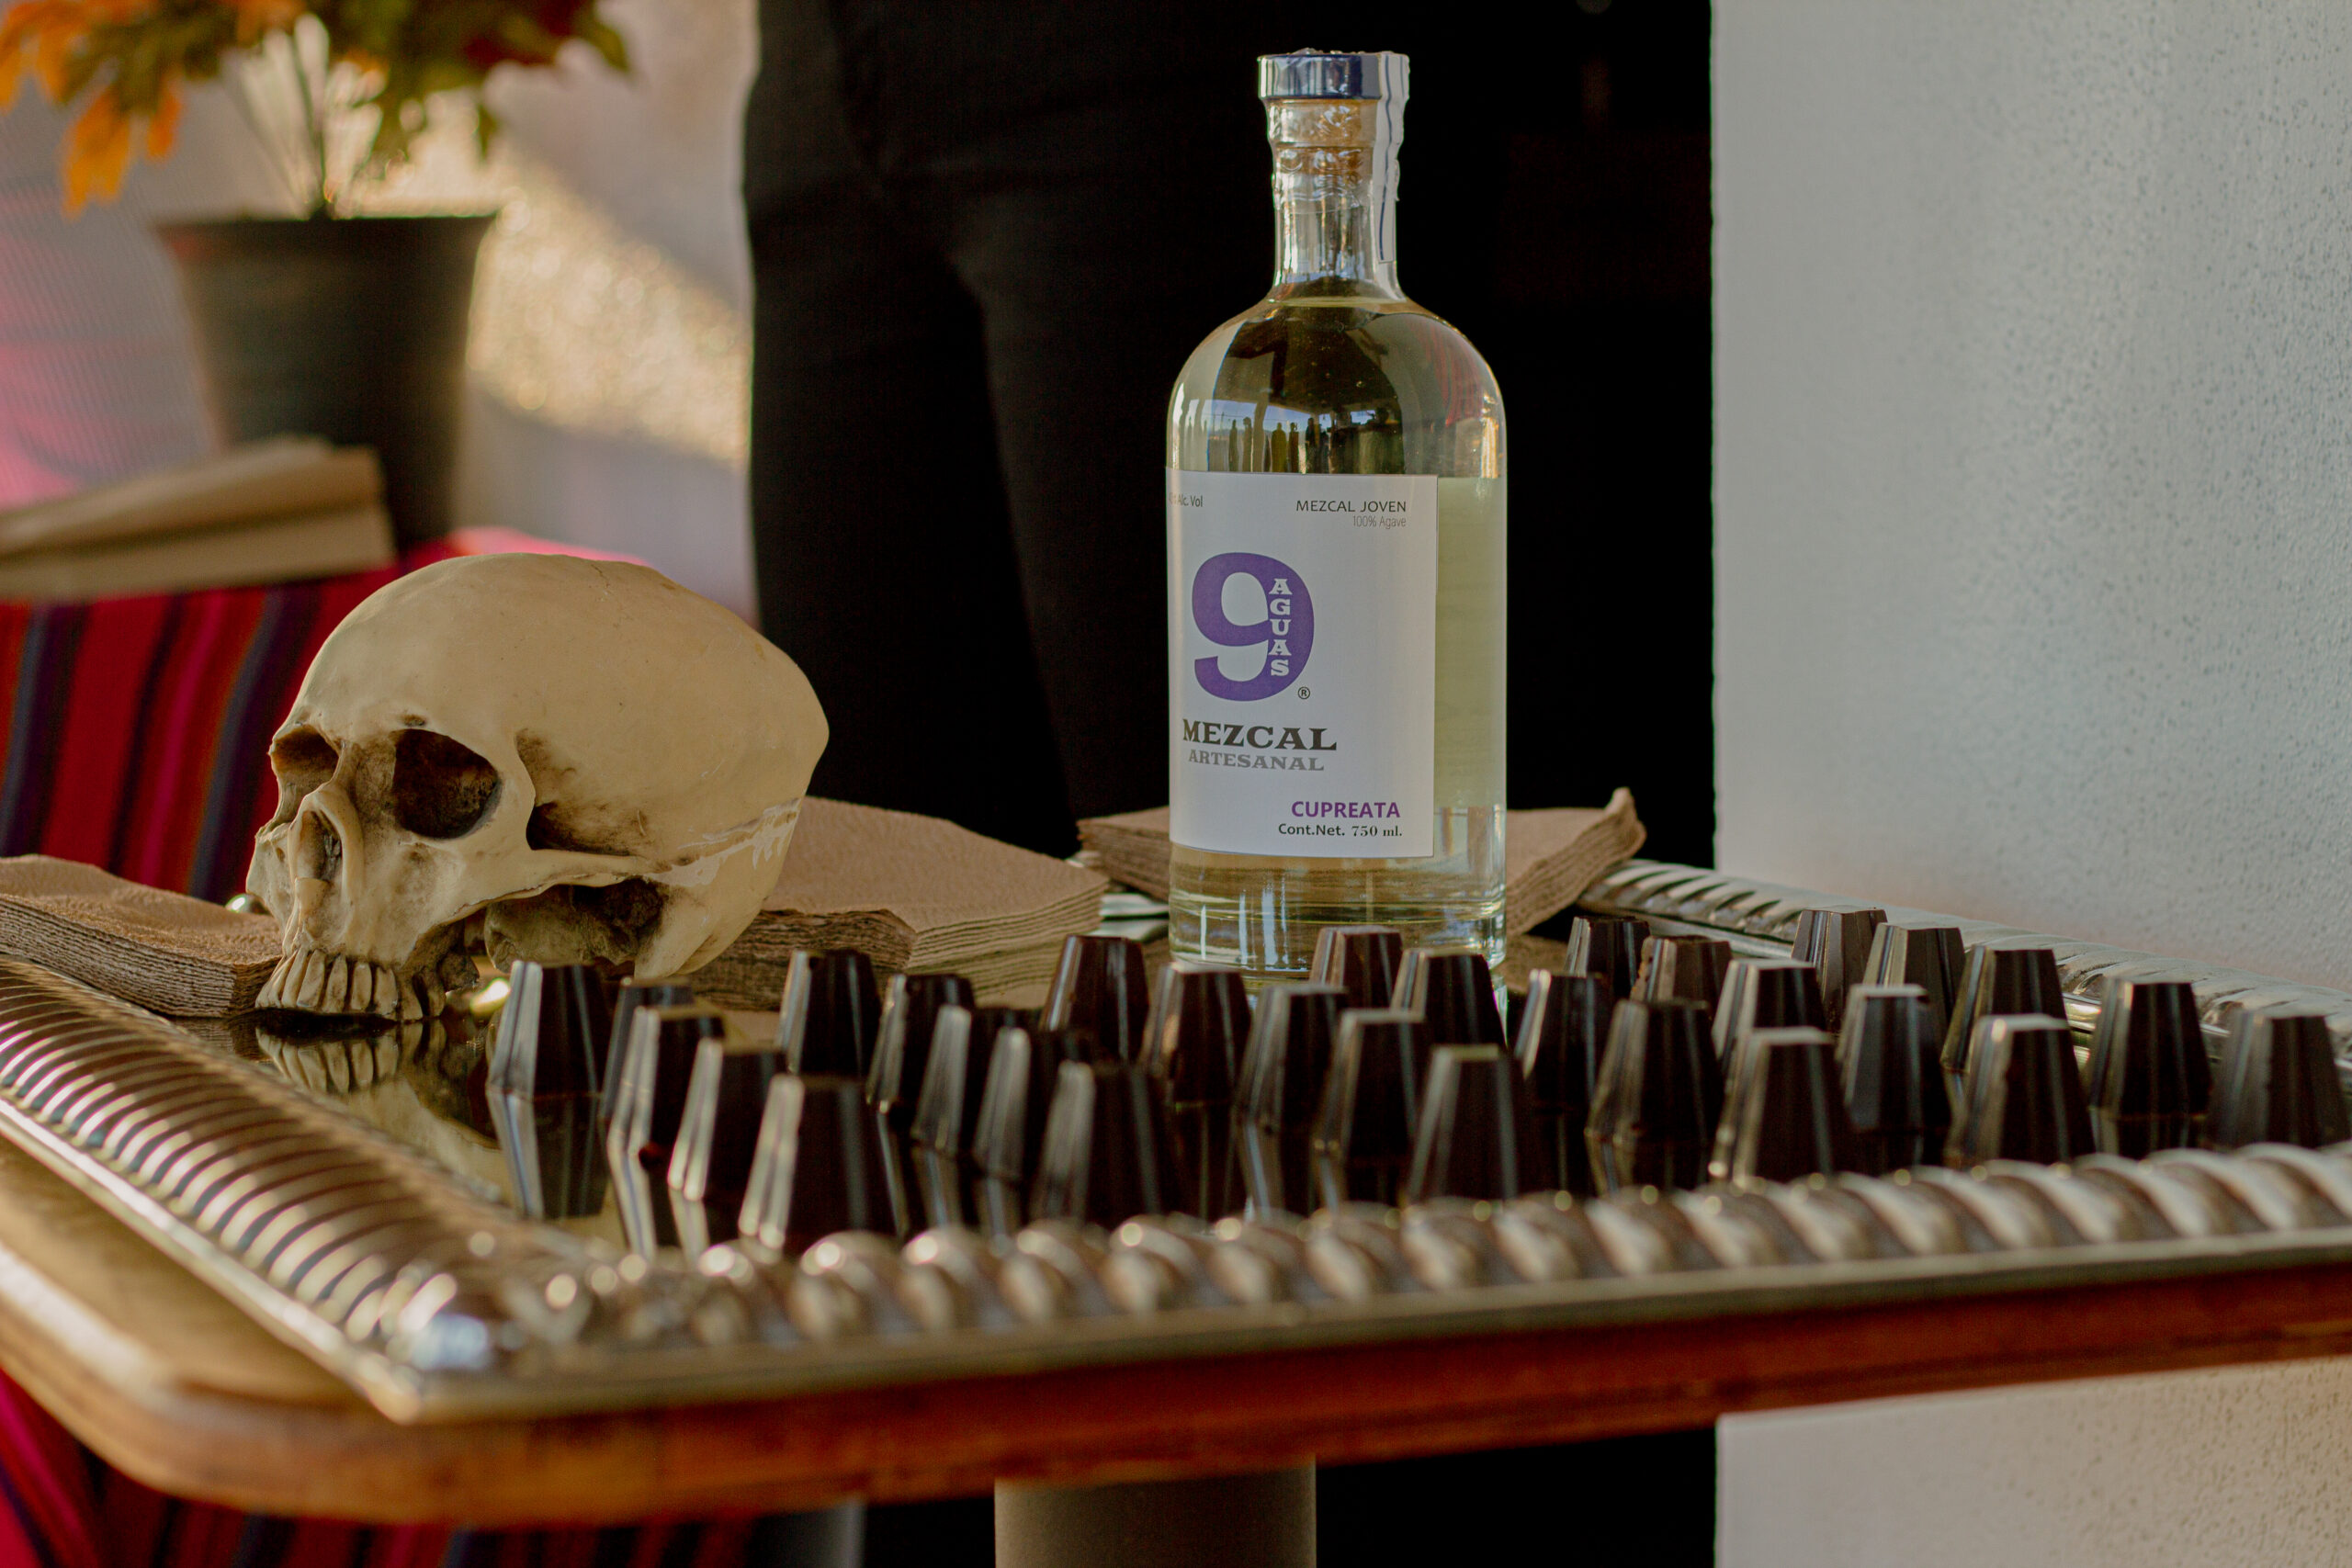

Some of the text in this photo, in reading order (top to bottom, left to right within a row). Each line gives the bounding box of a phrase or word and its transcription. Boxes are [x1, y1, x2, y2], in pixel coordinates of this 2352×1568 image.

[1190, 495, 1204, 508] Vol
[1295, 500, 1407, 513] MEZCAL JOVEN
[1353, 515, 1407, 530] 100% Agave
[1192, 552, 1315, 702] 9
[1269, 578, 1292, 676] AGUAS
[1182, 718, 1337, 750] MEZCAL
[1188, 749, 1325, 772] ARTESANAL
[1291, 801, 1401, 818] CUPREATA
[1351, 825, 1378, 837] 750
[1383, 825, 1403, 837] ml.
